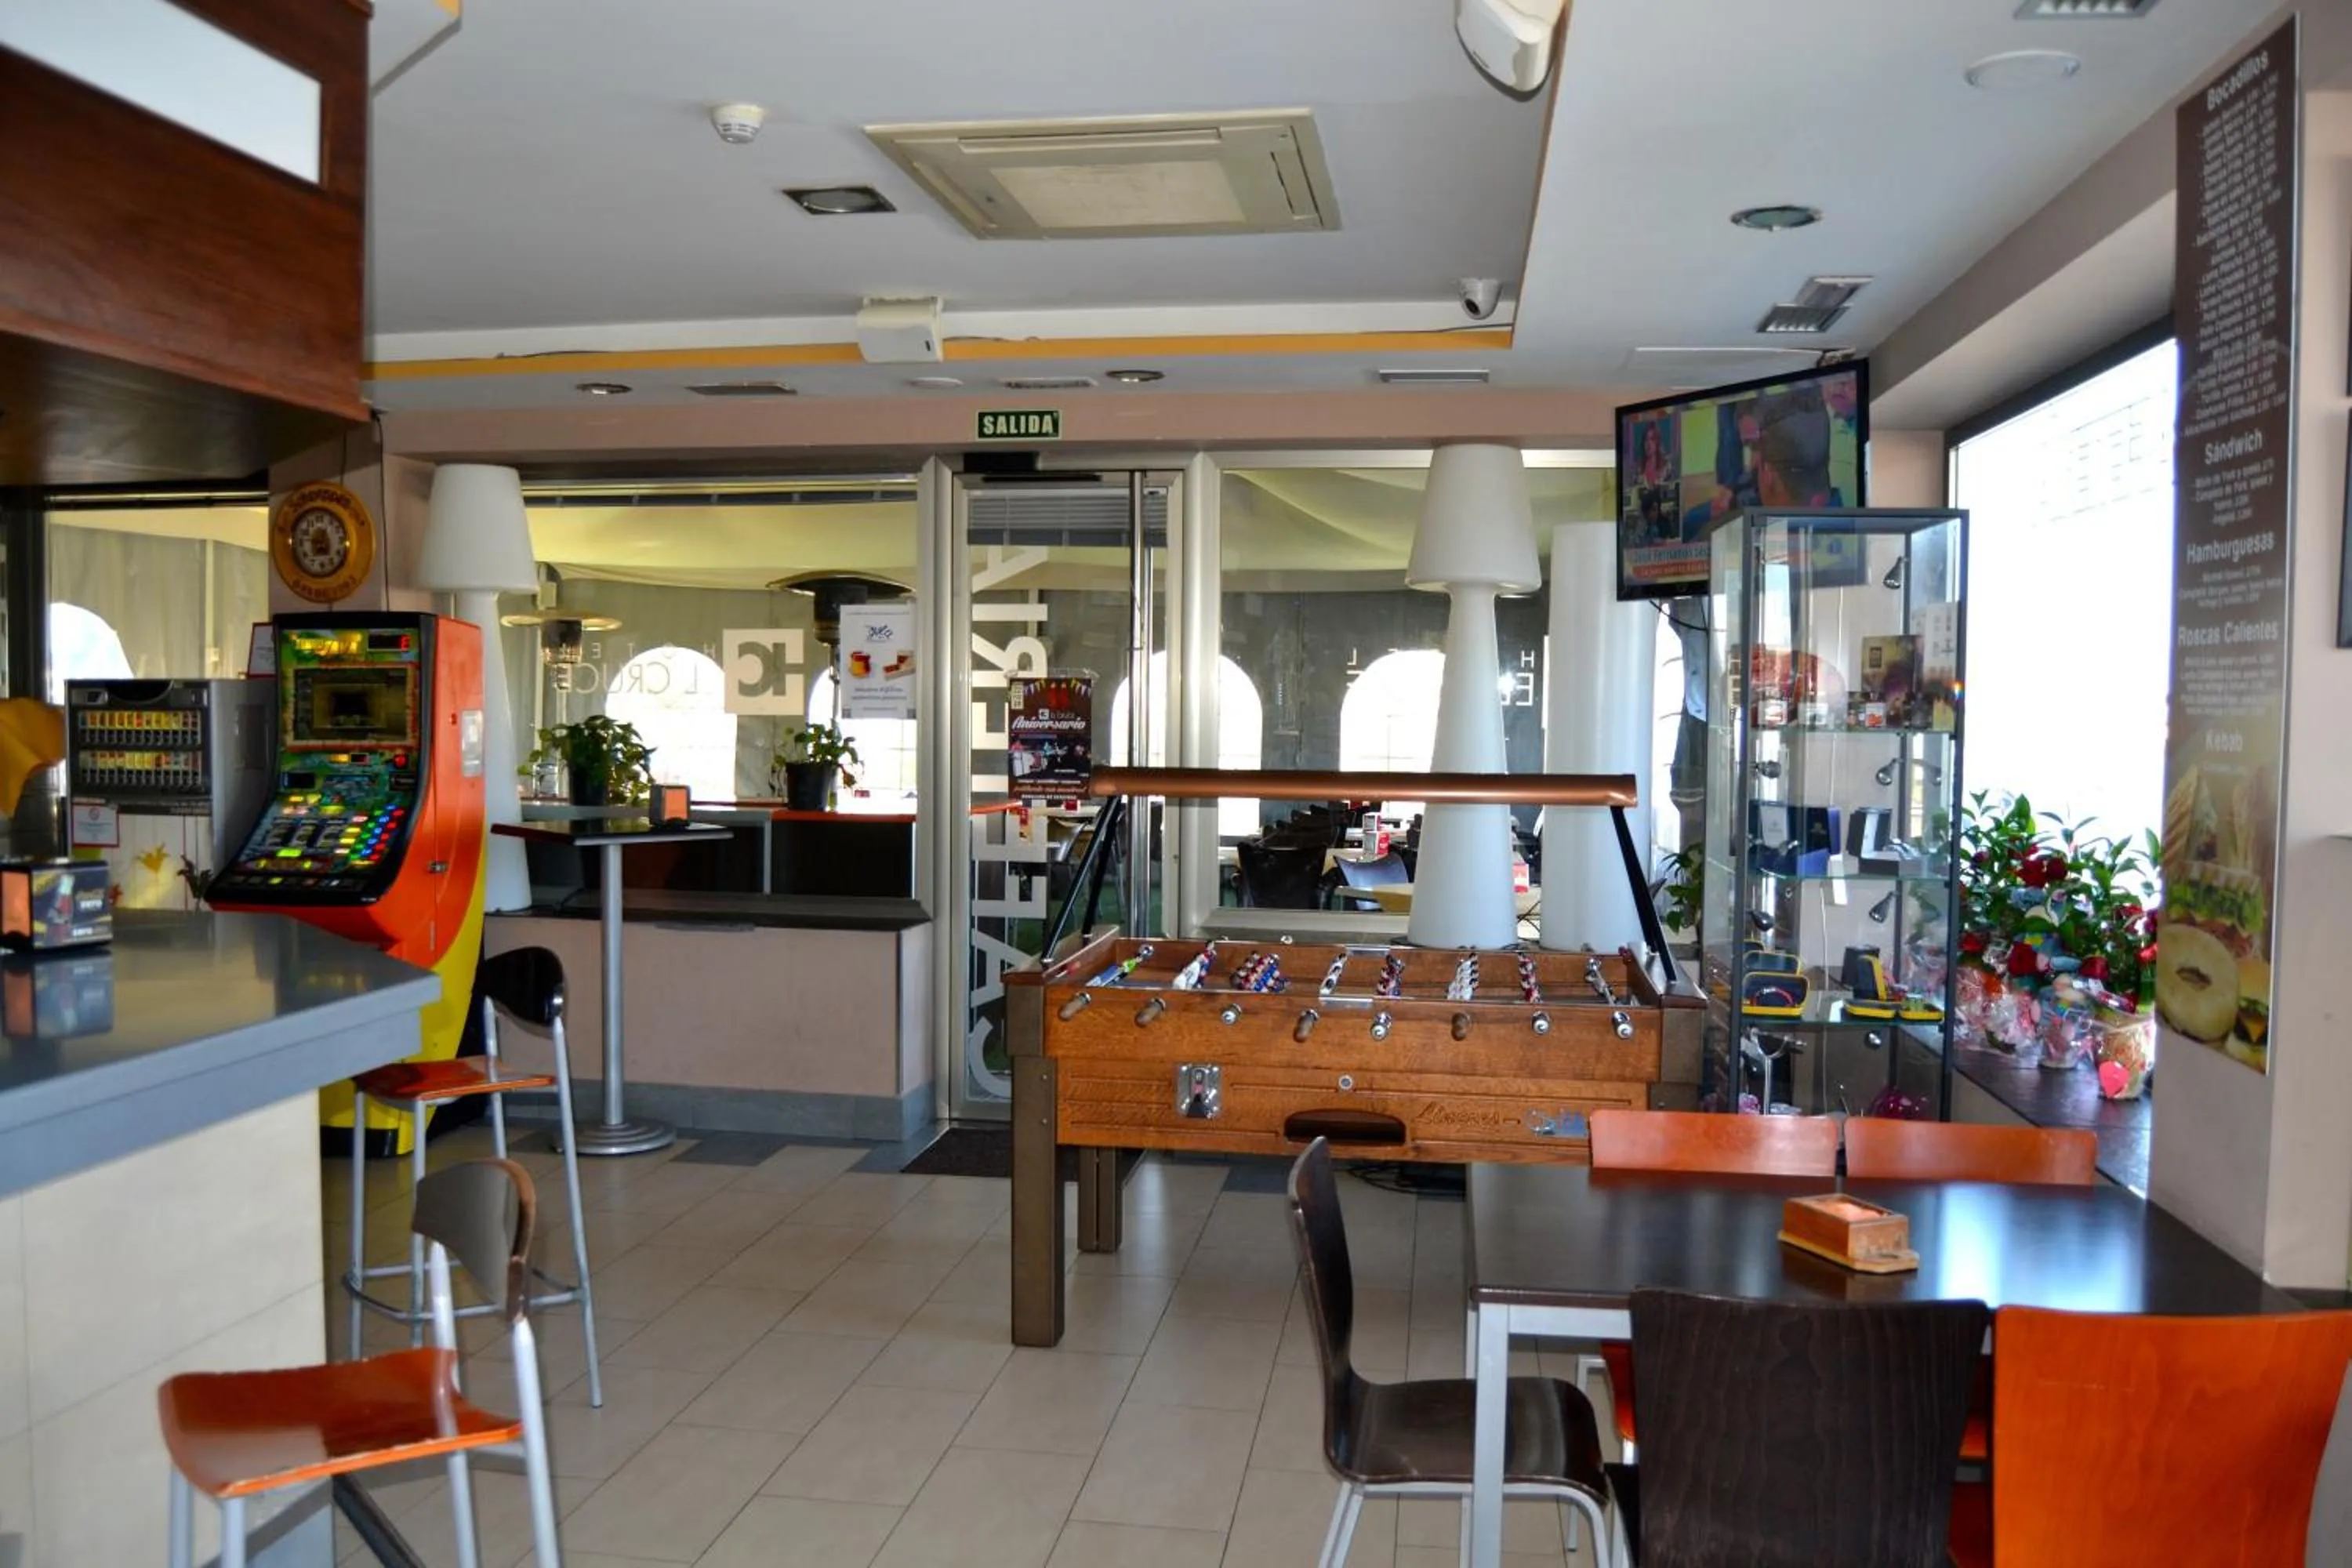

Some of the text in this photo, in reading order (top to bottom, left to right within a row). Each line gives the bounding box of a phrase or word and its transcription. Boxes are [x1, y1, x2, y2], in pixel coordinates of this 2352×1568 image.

[2206, 50, 2269, 111] Bocadillos
[982, 415, 1053, 434] SALIDA
[2186, 532, 2274, 564] Hamburguesas
[2178, 621, 2278, 646] Roscas Calientes
[1011, 714, 1086, 731] Aniversario
[2205, 728, 2243, 753] Kebab
